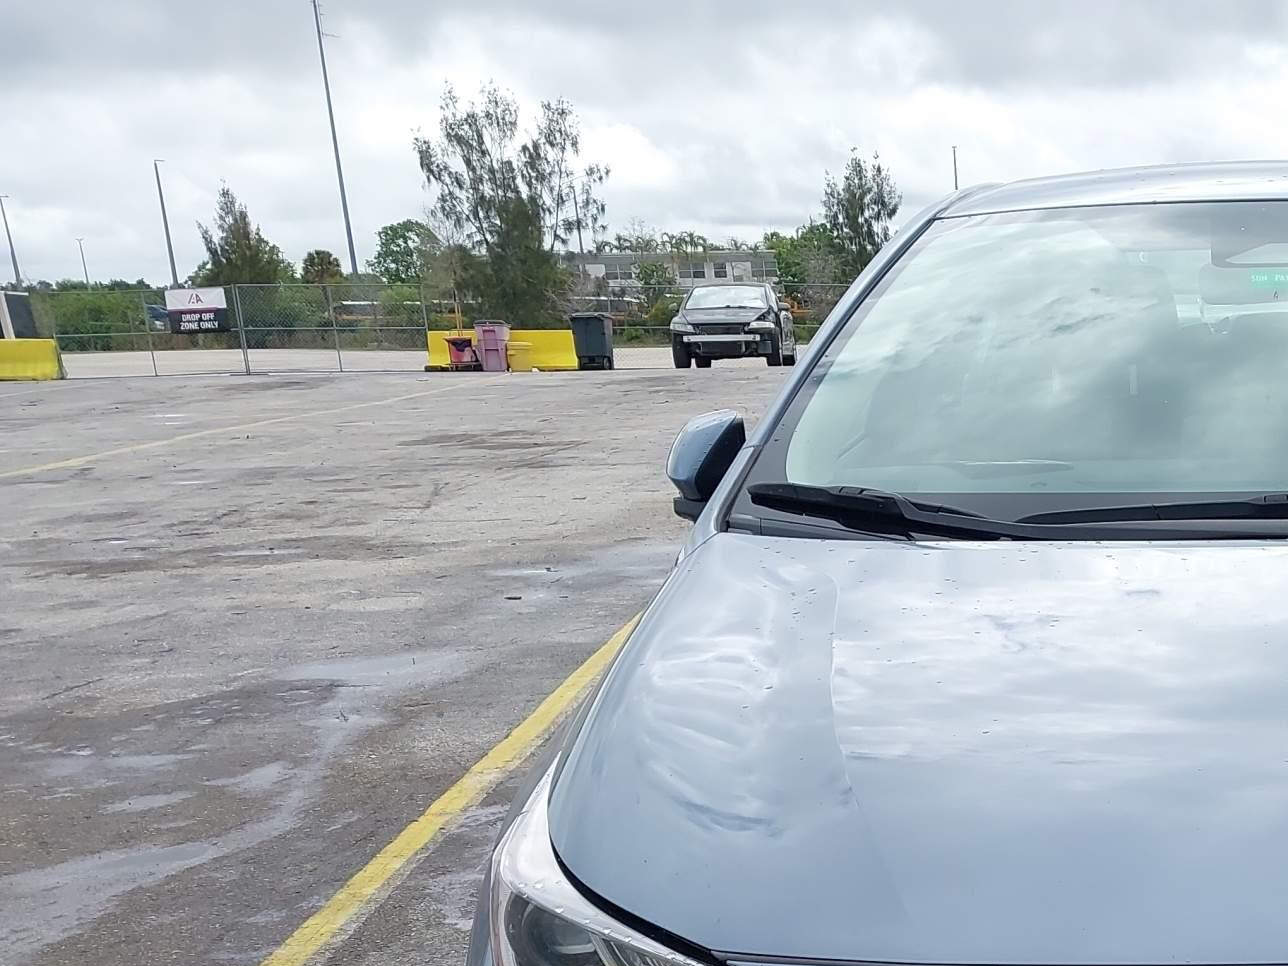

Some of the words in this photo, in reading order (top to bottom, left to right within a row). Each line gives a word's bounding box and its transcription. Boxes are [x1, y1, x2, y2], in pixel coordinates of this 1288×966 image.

[181, 313, 200, 322] DROP
[201, 312, 215, 321] OFF
[179, 322, 200, 330] ZONE
[199, 321, 219, 329] ONLY
